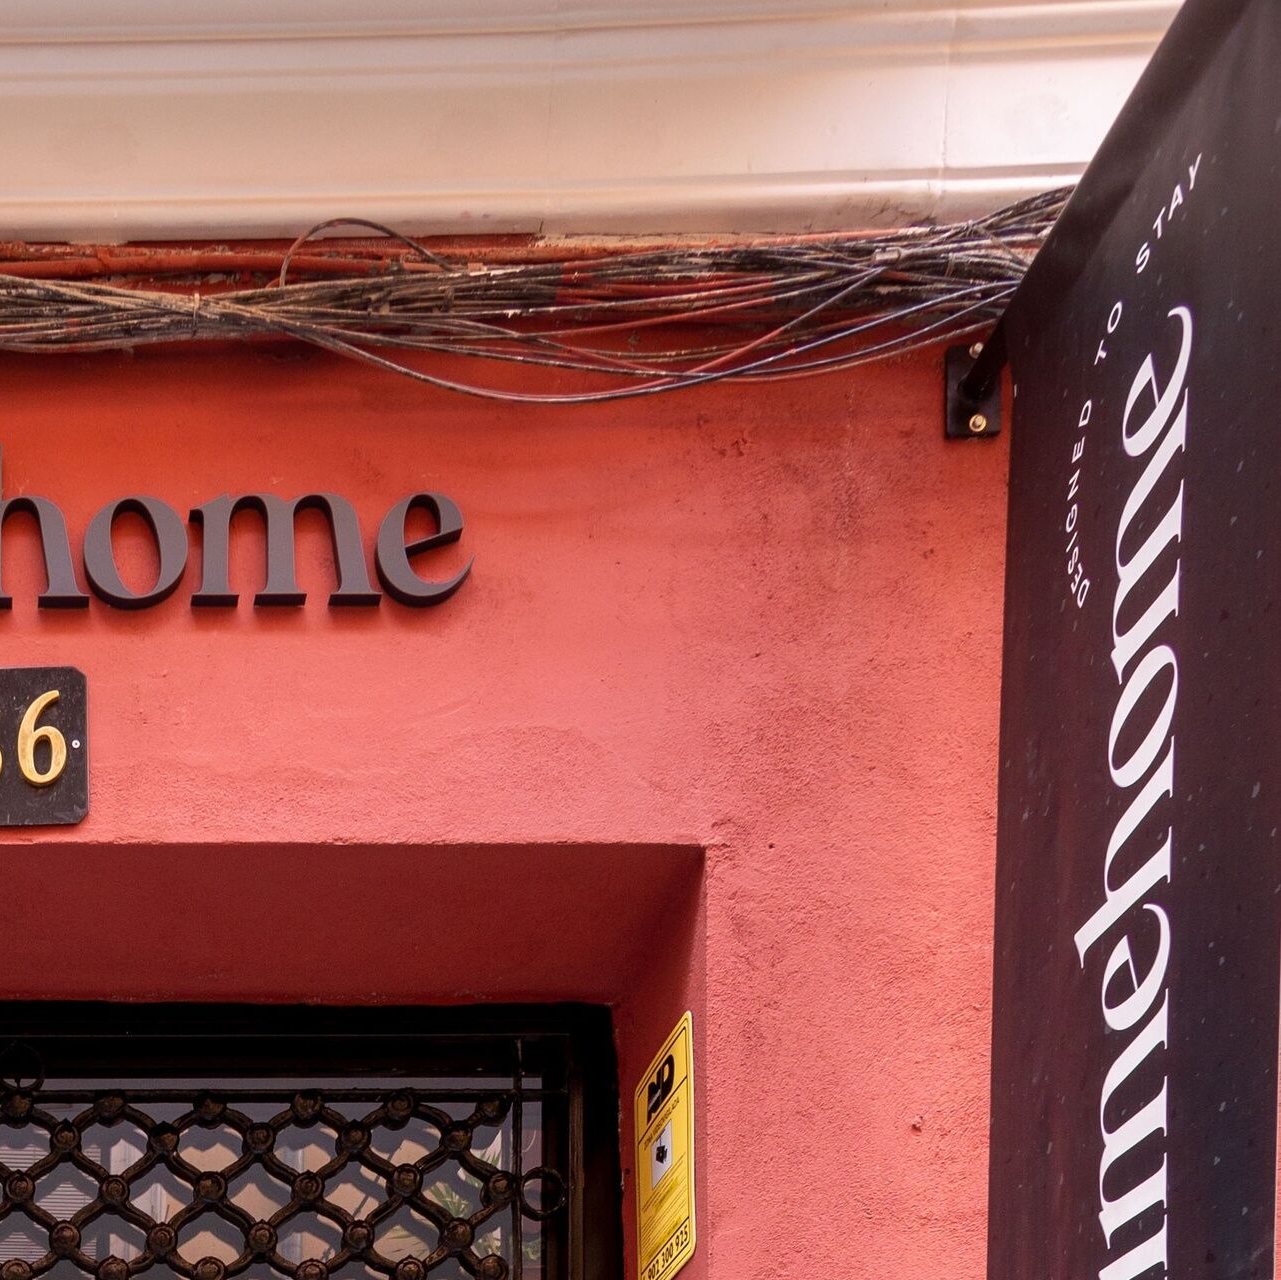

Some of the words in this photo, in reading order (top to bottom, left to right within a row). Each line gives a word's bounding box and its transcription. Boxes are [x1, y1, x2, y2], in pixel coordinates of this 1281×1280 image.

[1065, 399, 1092, 609] DESIGNED
[1094, 300, 1123, 367] TO
[1135, 152, 1202, 275] STAY
[661, 1242, 674, 1268] 300
[675, 1224, 688, 1251] 925
